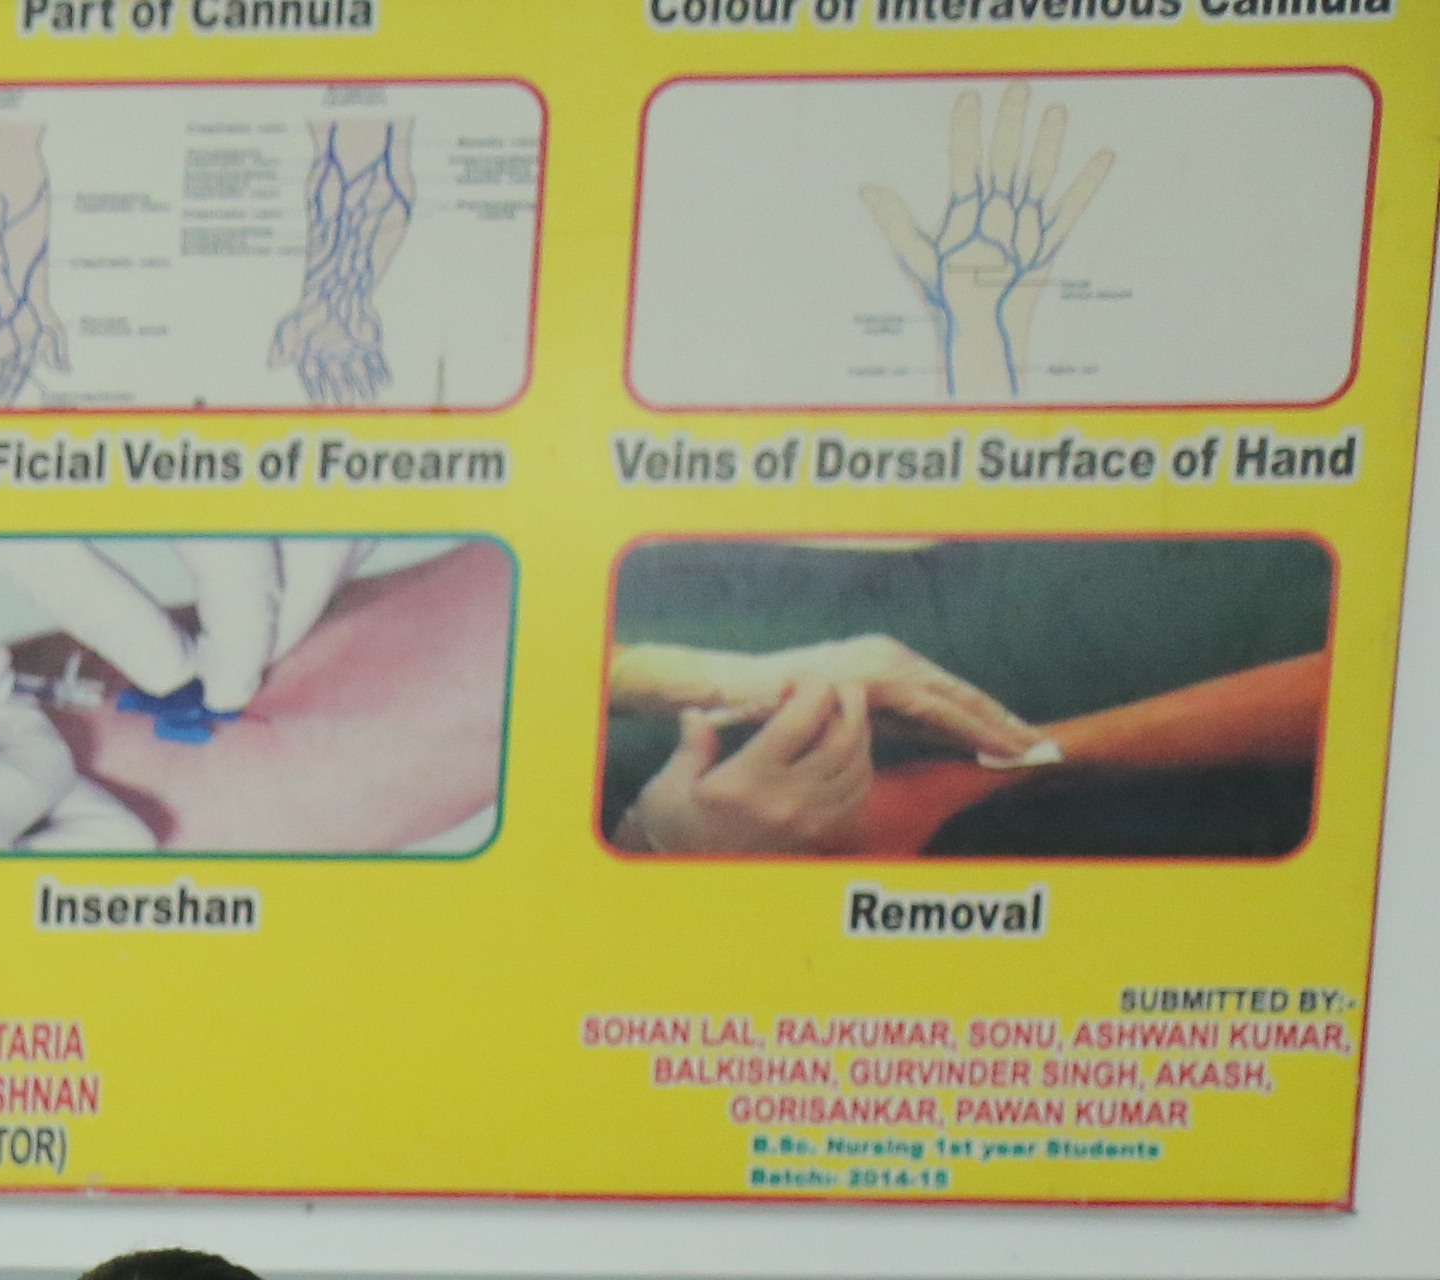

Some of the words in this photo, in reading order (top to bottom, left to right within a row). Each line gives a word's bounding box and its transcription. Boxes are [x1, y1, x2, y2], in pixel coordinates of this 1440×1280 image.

[124, 440, 241, 481] Veins
[260, 439, 302, 480] of
[319, 440, 504, 481] Forearm
[613, 439, 736, 481] Veins
[753, 439, 799, 481] of
[817, 439, 961, 481] Dorsal
[979, 438, 1154, 480] Surface
[1174, 438, 1220, 480] of
[1236, 436, 1357, 479] Hand
[39, 884, 256, 927] Insershan
[850, 892, 1043, 933] Removal
[1120, 987, 1289, 1013] SUBMITTED
[584, 1017, 690, 1046] SOHAN
[701, 1017, 766, 1050] LAL,
[779, 1019, 957, 1052] RAJKUMAR,
[968, 1020, 1063, 1053] SONU,
[1073, 1021, 1219, 1051] ASHWANI
[1230, 1023, 1352, 1054] KUMAR,
[654, 1056, 839, 1090] BALKISHAN,
[849, 1058, 1032, 1088] GURVINDER
[1042, 1060, 1144, 1092] SINGH,
[1155, 1061, 1273, 1093] AKASH,
[730, 1096, 945, 1130] GORISANKAR,
[955, 1097, 1065, 1127] PAWAN
[1075, 1098, 1190, 1128] KUMAR
[828, 1136, 923, 1160] Nursing
[983, 1140, 1036, 1161] year
[1047, 1138, 1161, 1159] Students
